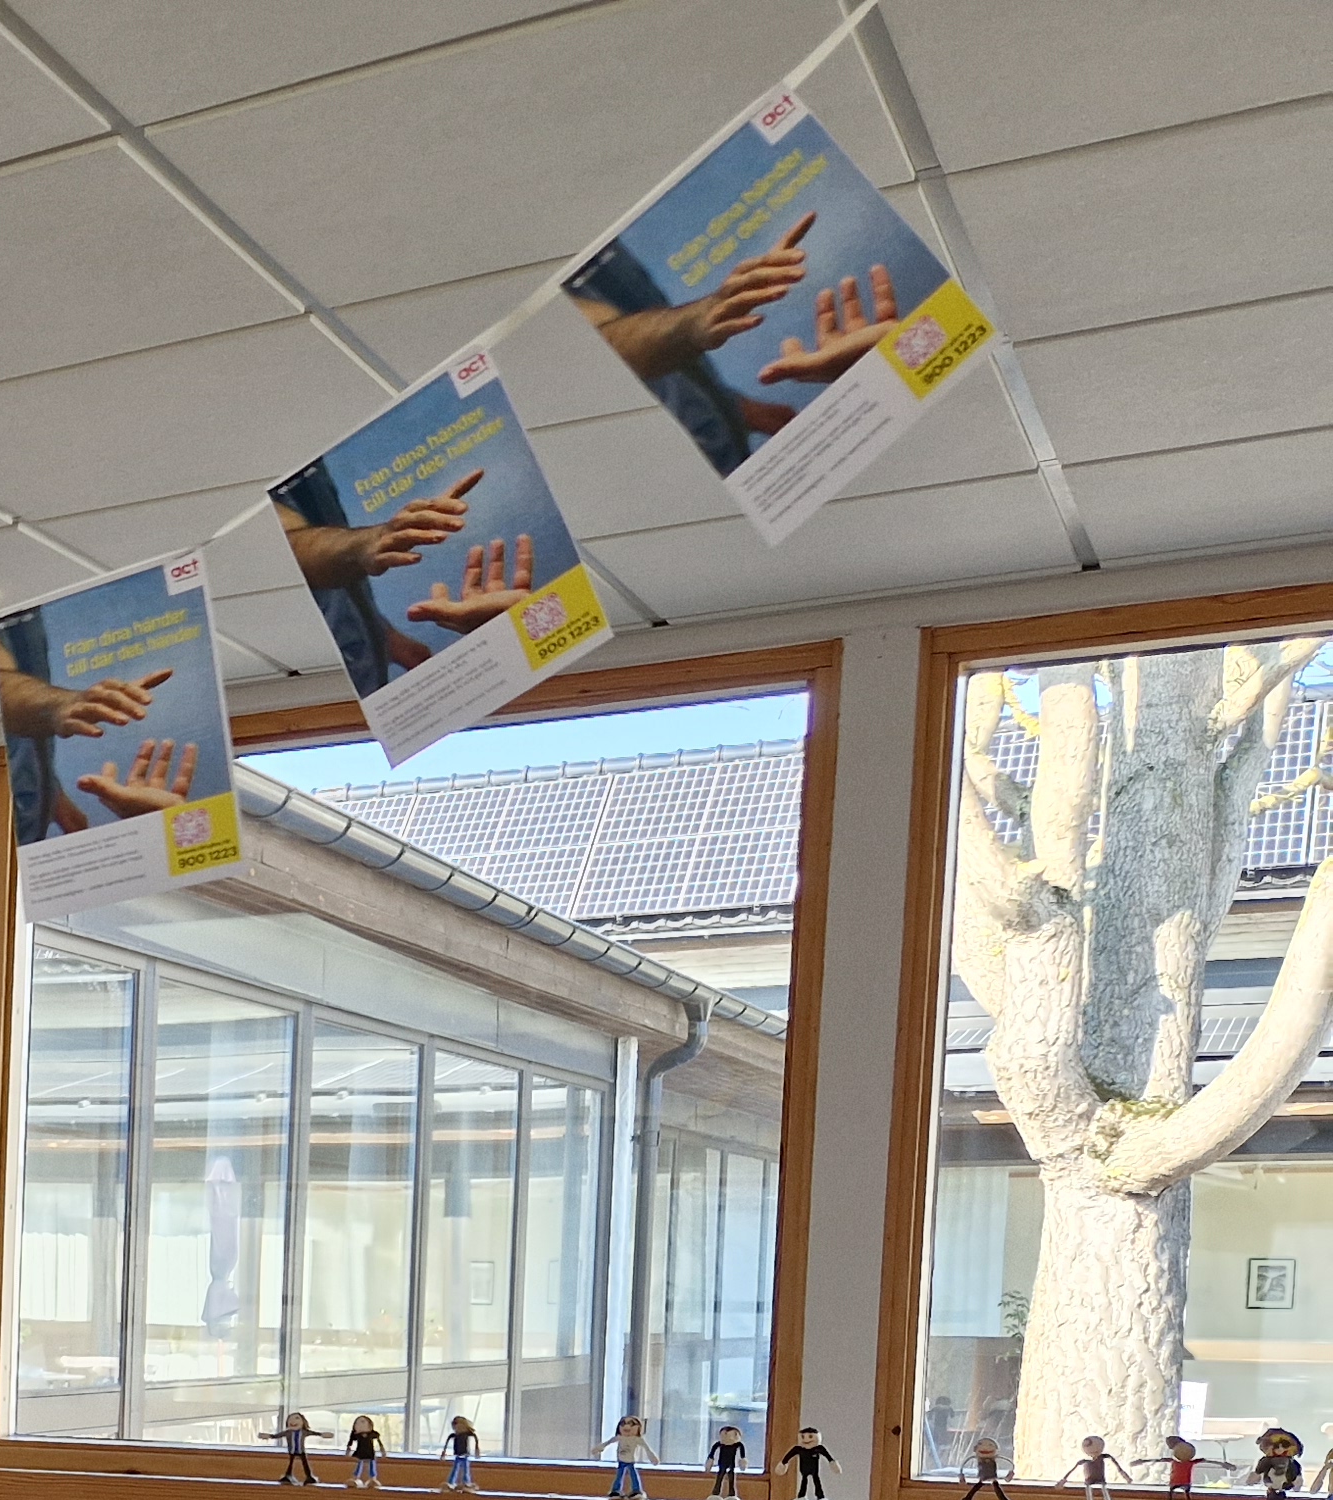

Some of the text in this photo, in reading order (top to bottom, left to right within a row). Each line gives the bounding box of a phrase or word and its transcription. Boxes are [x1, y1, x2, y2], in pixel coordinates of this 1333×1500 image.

[763, 94, 794, 127] act
[458, 353, 487, 380] act
[171, 558, 198, 578] act
[538, 635, 567, 660] 900
[568, 615, 601, 639] 1223
[178, 852, 206, 869] 900
[209, 846, 238, 860] 1223
